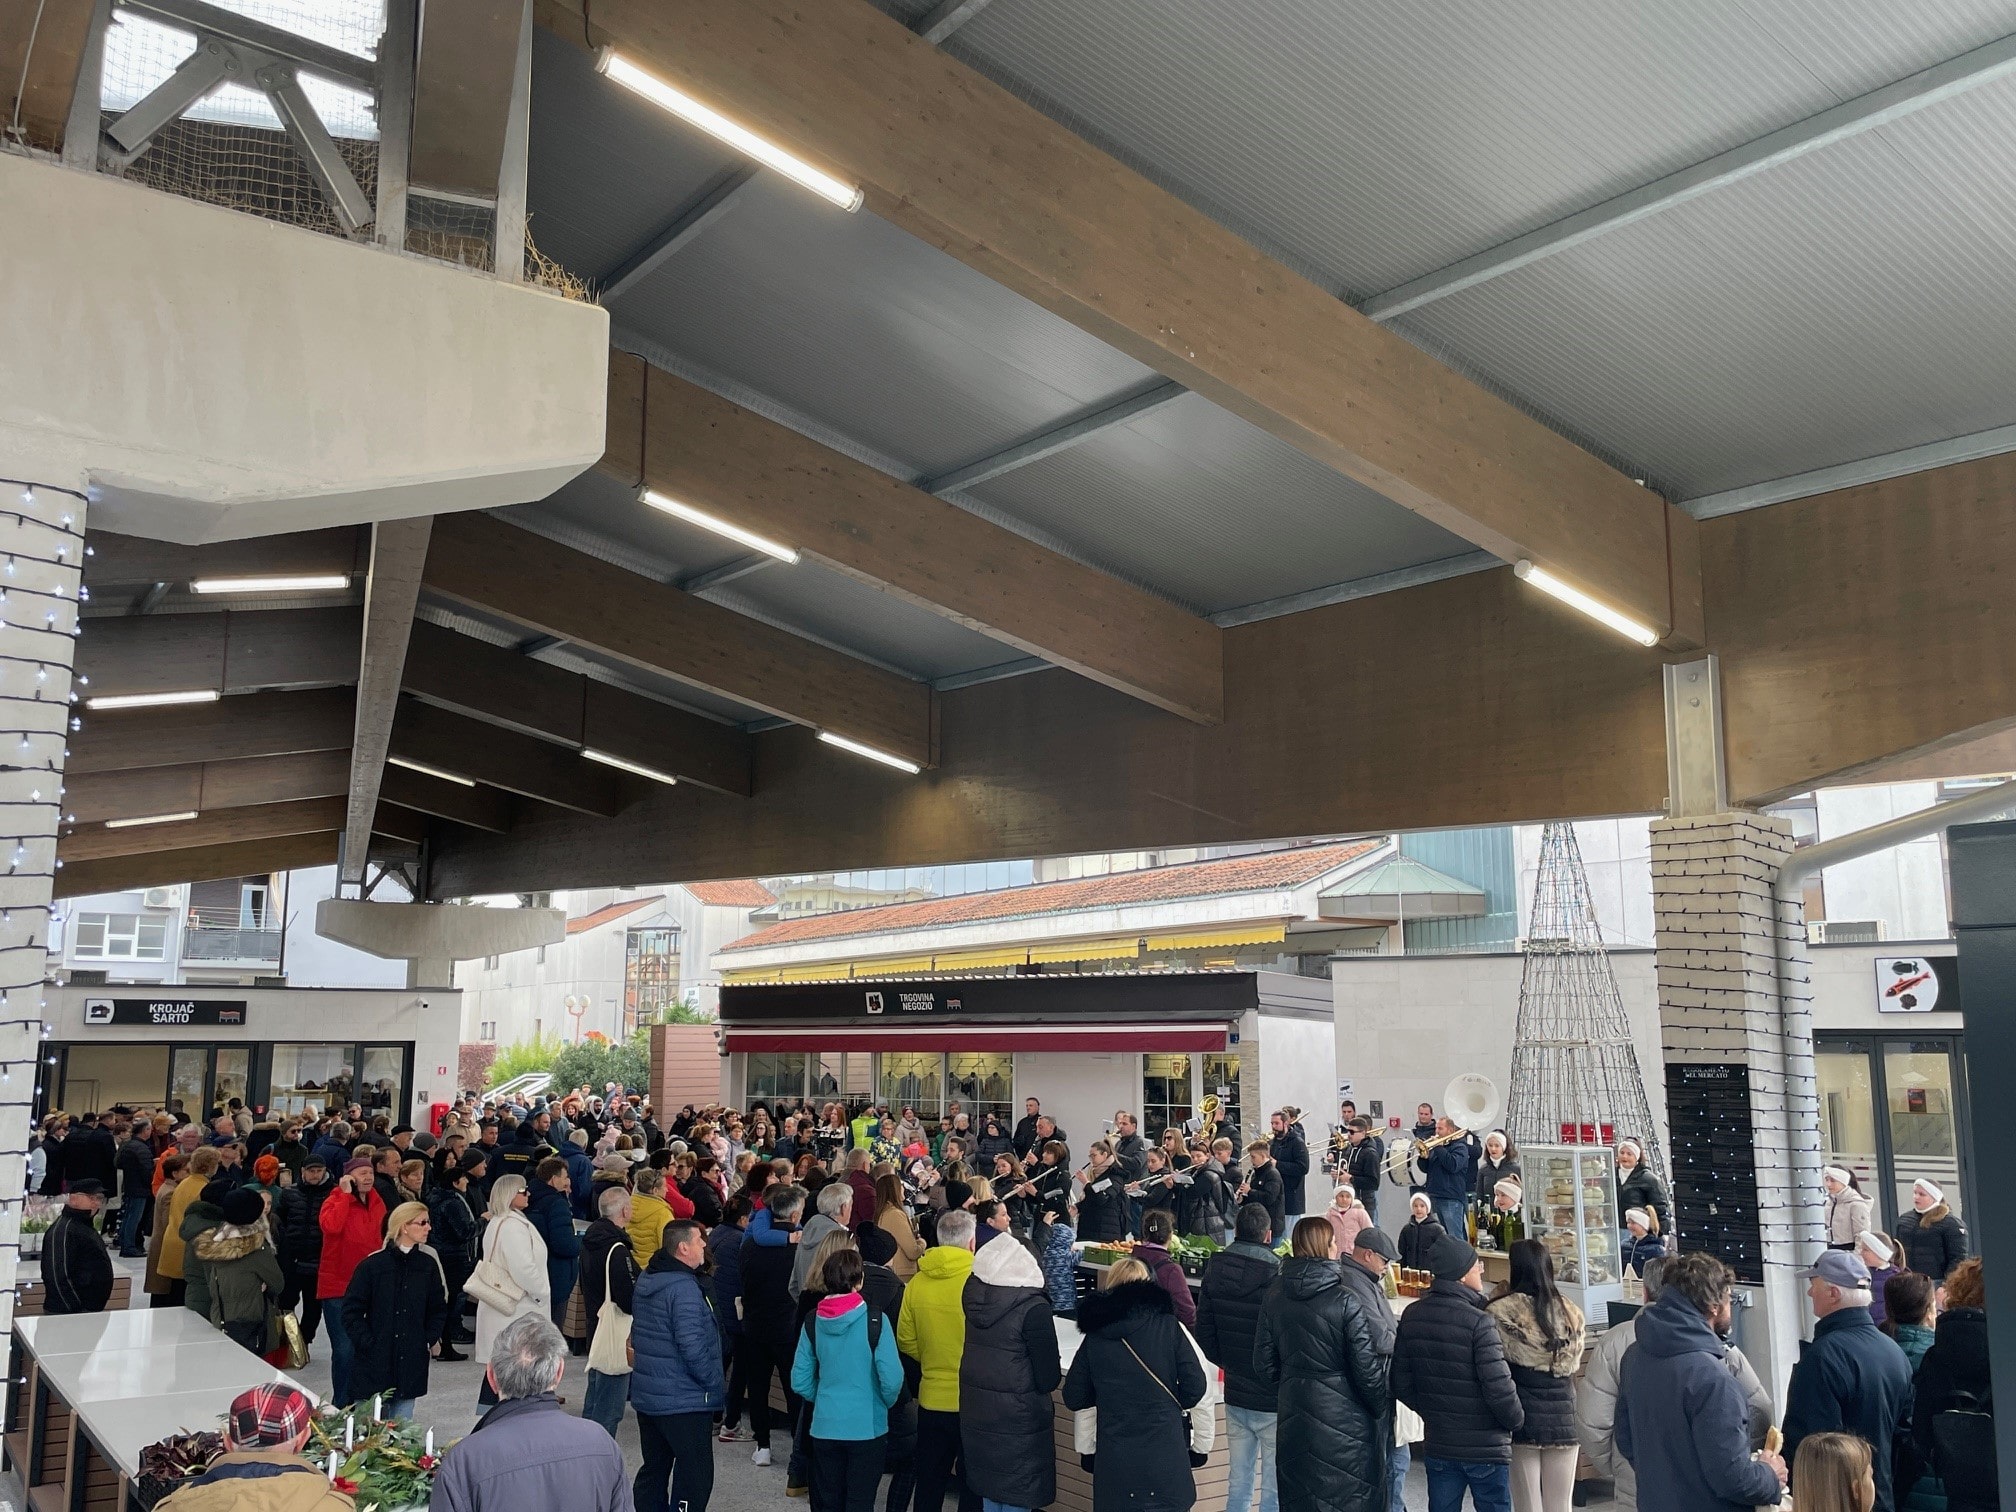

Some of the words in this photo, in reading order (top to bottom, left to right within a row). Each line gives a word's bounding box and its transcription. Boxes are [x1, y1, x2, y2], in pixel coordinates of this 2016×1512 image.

[899, 993, 935, 1002] TRGOVINA
[149, 1002, 194, 1013] KROJAČ
[902, 1002, 933, 1011] NEGOZIO
[152, 1013, 190, 1023] SARTO
